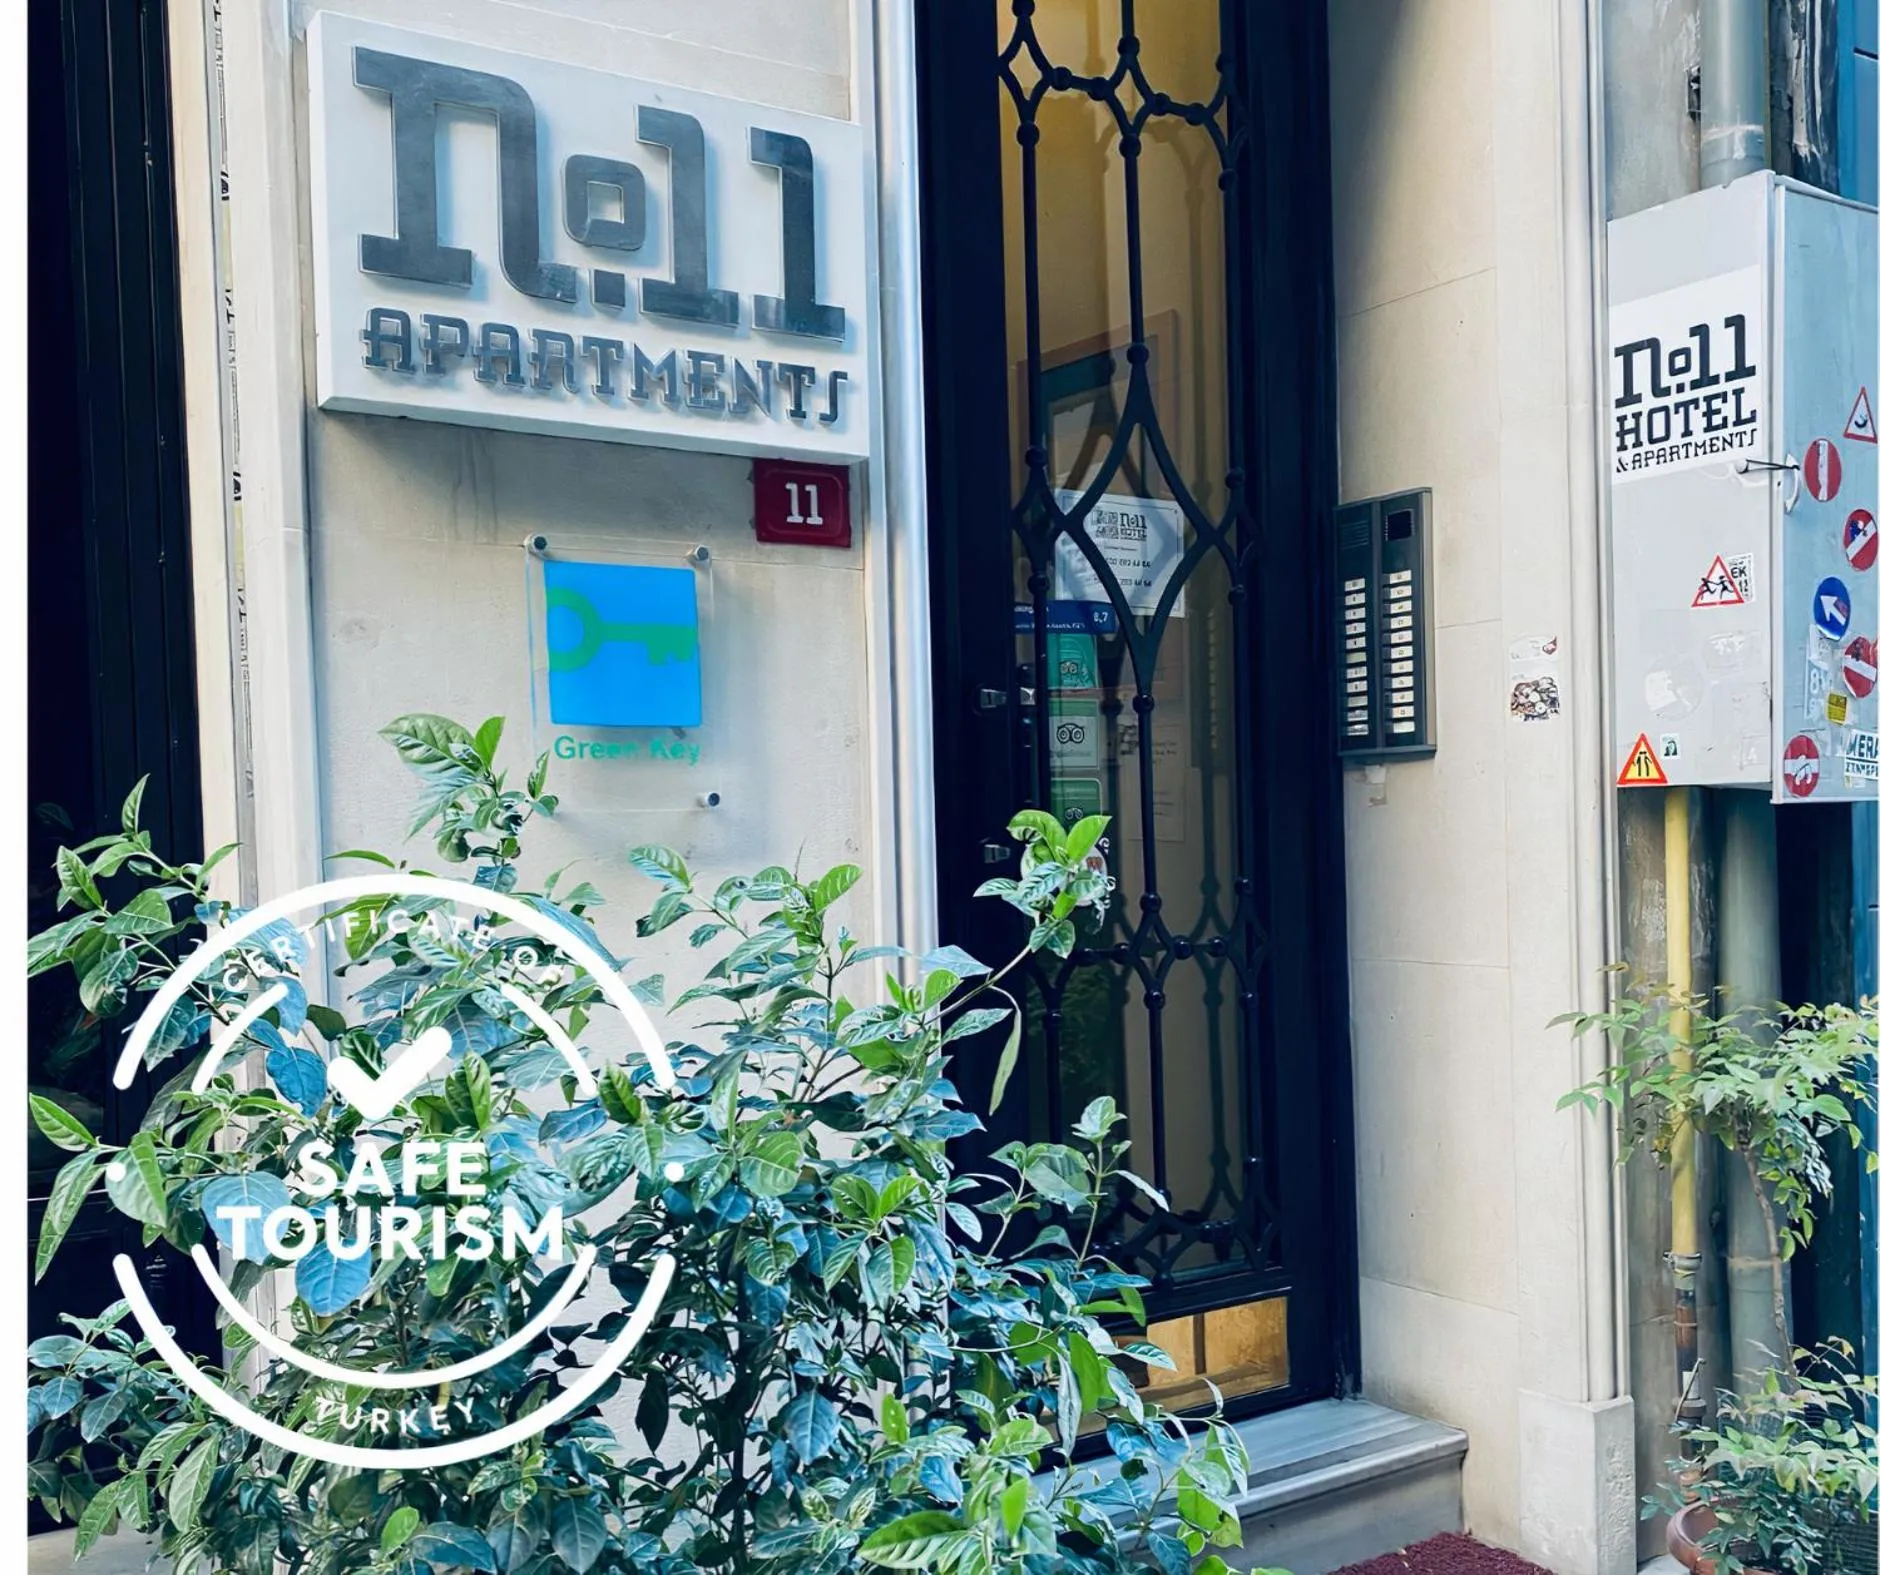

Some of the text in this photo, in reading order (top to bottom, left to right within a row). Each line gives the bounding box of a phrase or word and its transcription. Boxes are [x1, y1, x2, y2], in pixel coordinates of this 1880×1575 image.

[359, 306, 848, 425] APARTMENTS
[1615, 386, 1758, 452] HOTEL
[1631, 428, 1758, 470] APARTMENTS
[784, 482, 824, 525] 11
[553, 735, 700, 766] Green Key
